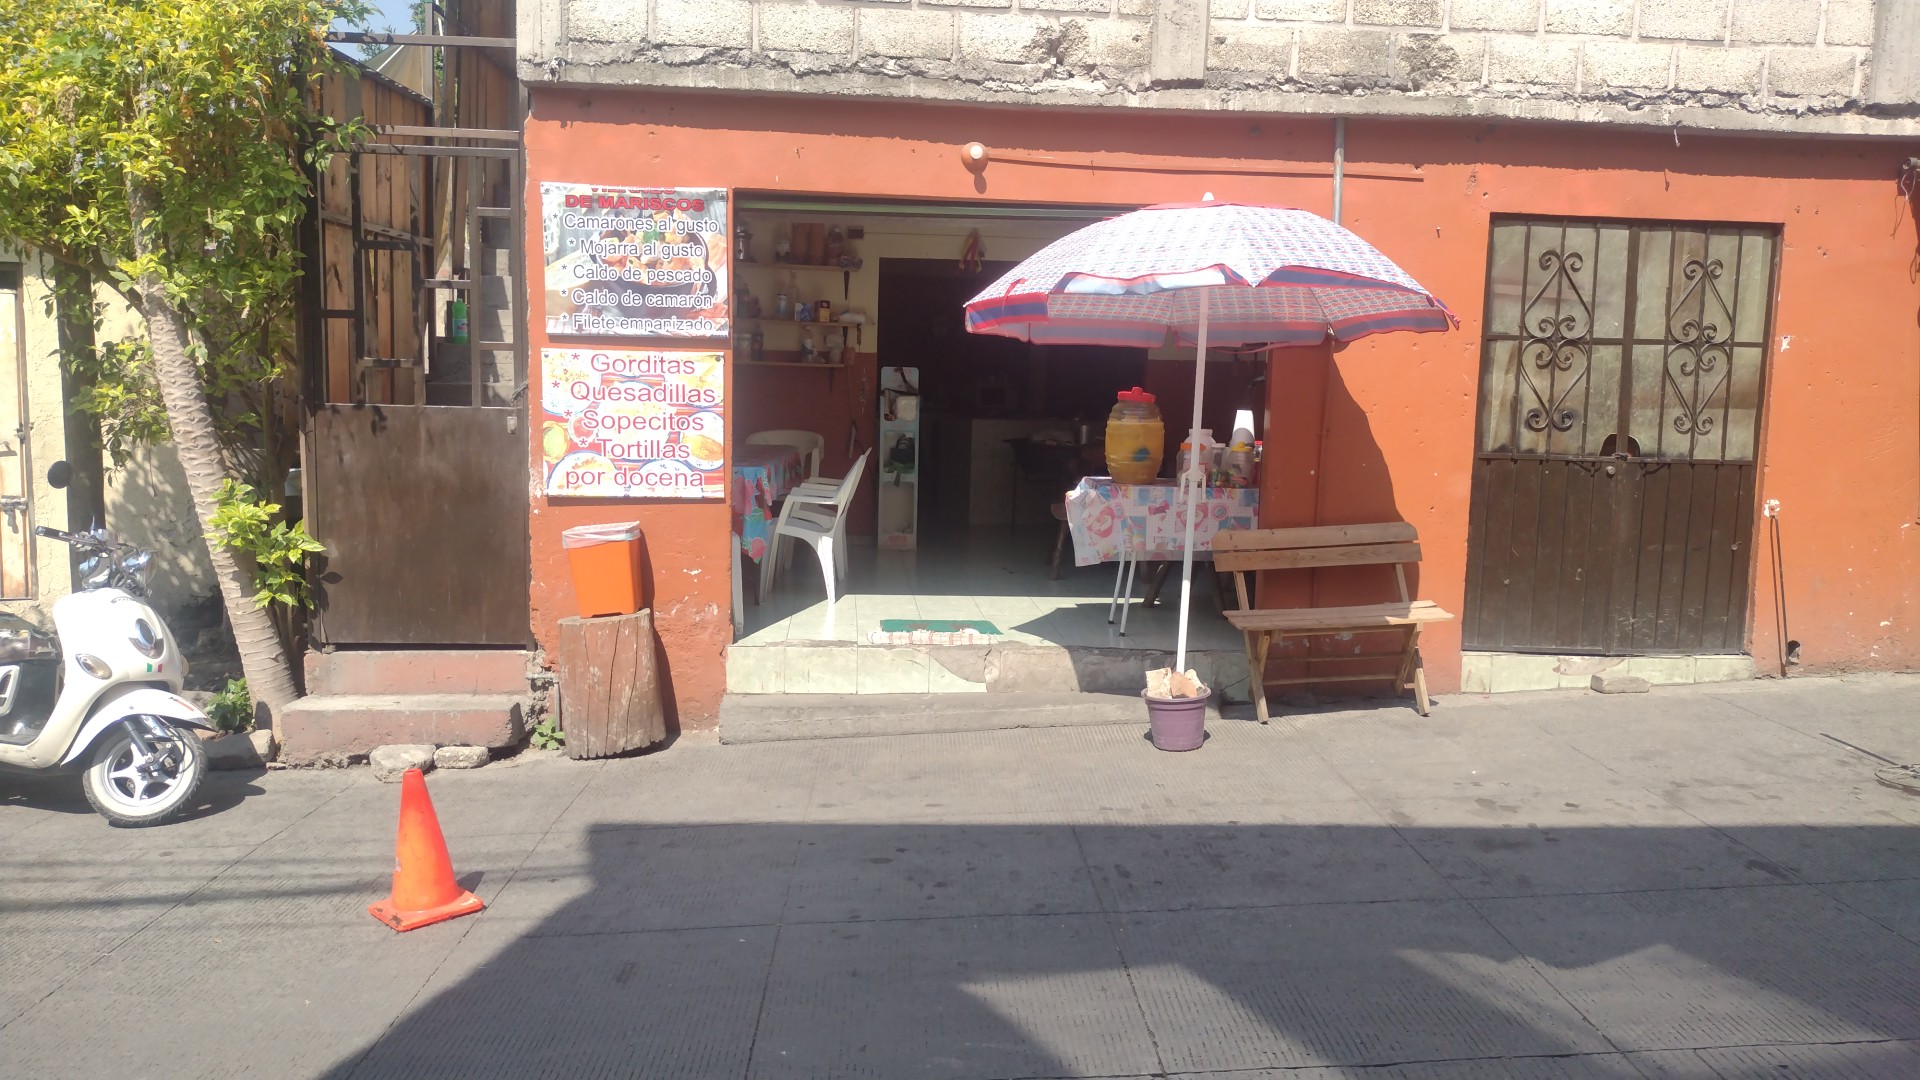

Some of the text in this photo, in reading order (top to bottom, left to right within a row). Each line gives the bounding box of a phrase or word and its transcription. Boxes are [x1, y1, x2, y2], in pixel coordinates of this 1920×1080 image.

[565, 195, 705, 212] DE MARISCOS
[564, 213, 718, 234] Camarones al gusto
[580, 239, 703, 259] Mojarra al gusto
[573, 264, 712, 286] Caldo de pescado
[572, 289, 713, 307] Caldo de camarón
[573, 314, 713, 332] Filete empanizado
[590, 353, 696, 375] Gorditas
[570, 381, 716, 403] Quesadillas
[583, 409, 704, 434] Sopecitos
[597, 438, 690, 459] Tortillas
[566, 467, 704, 489] por docena
